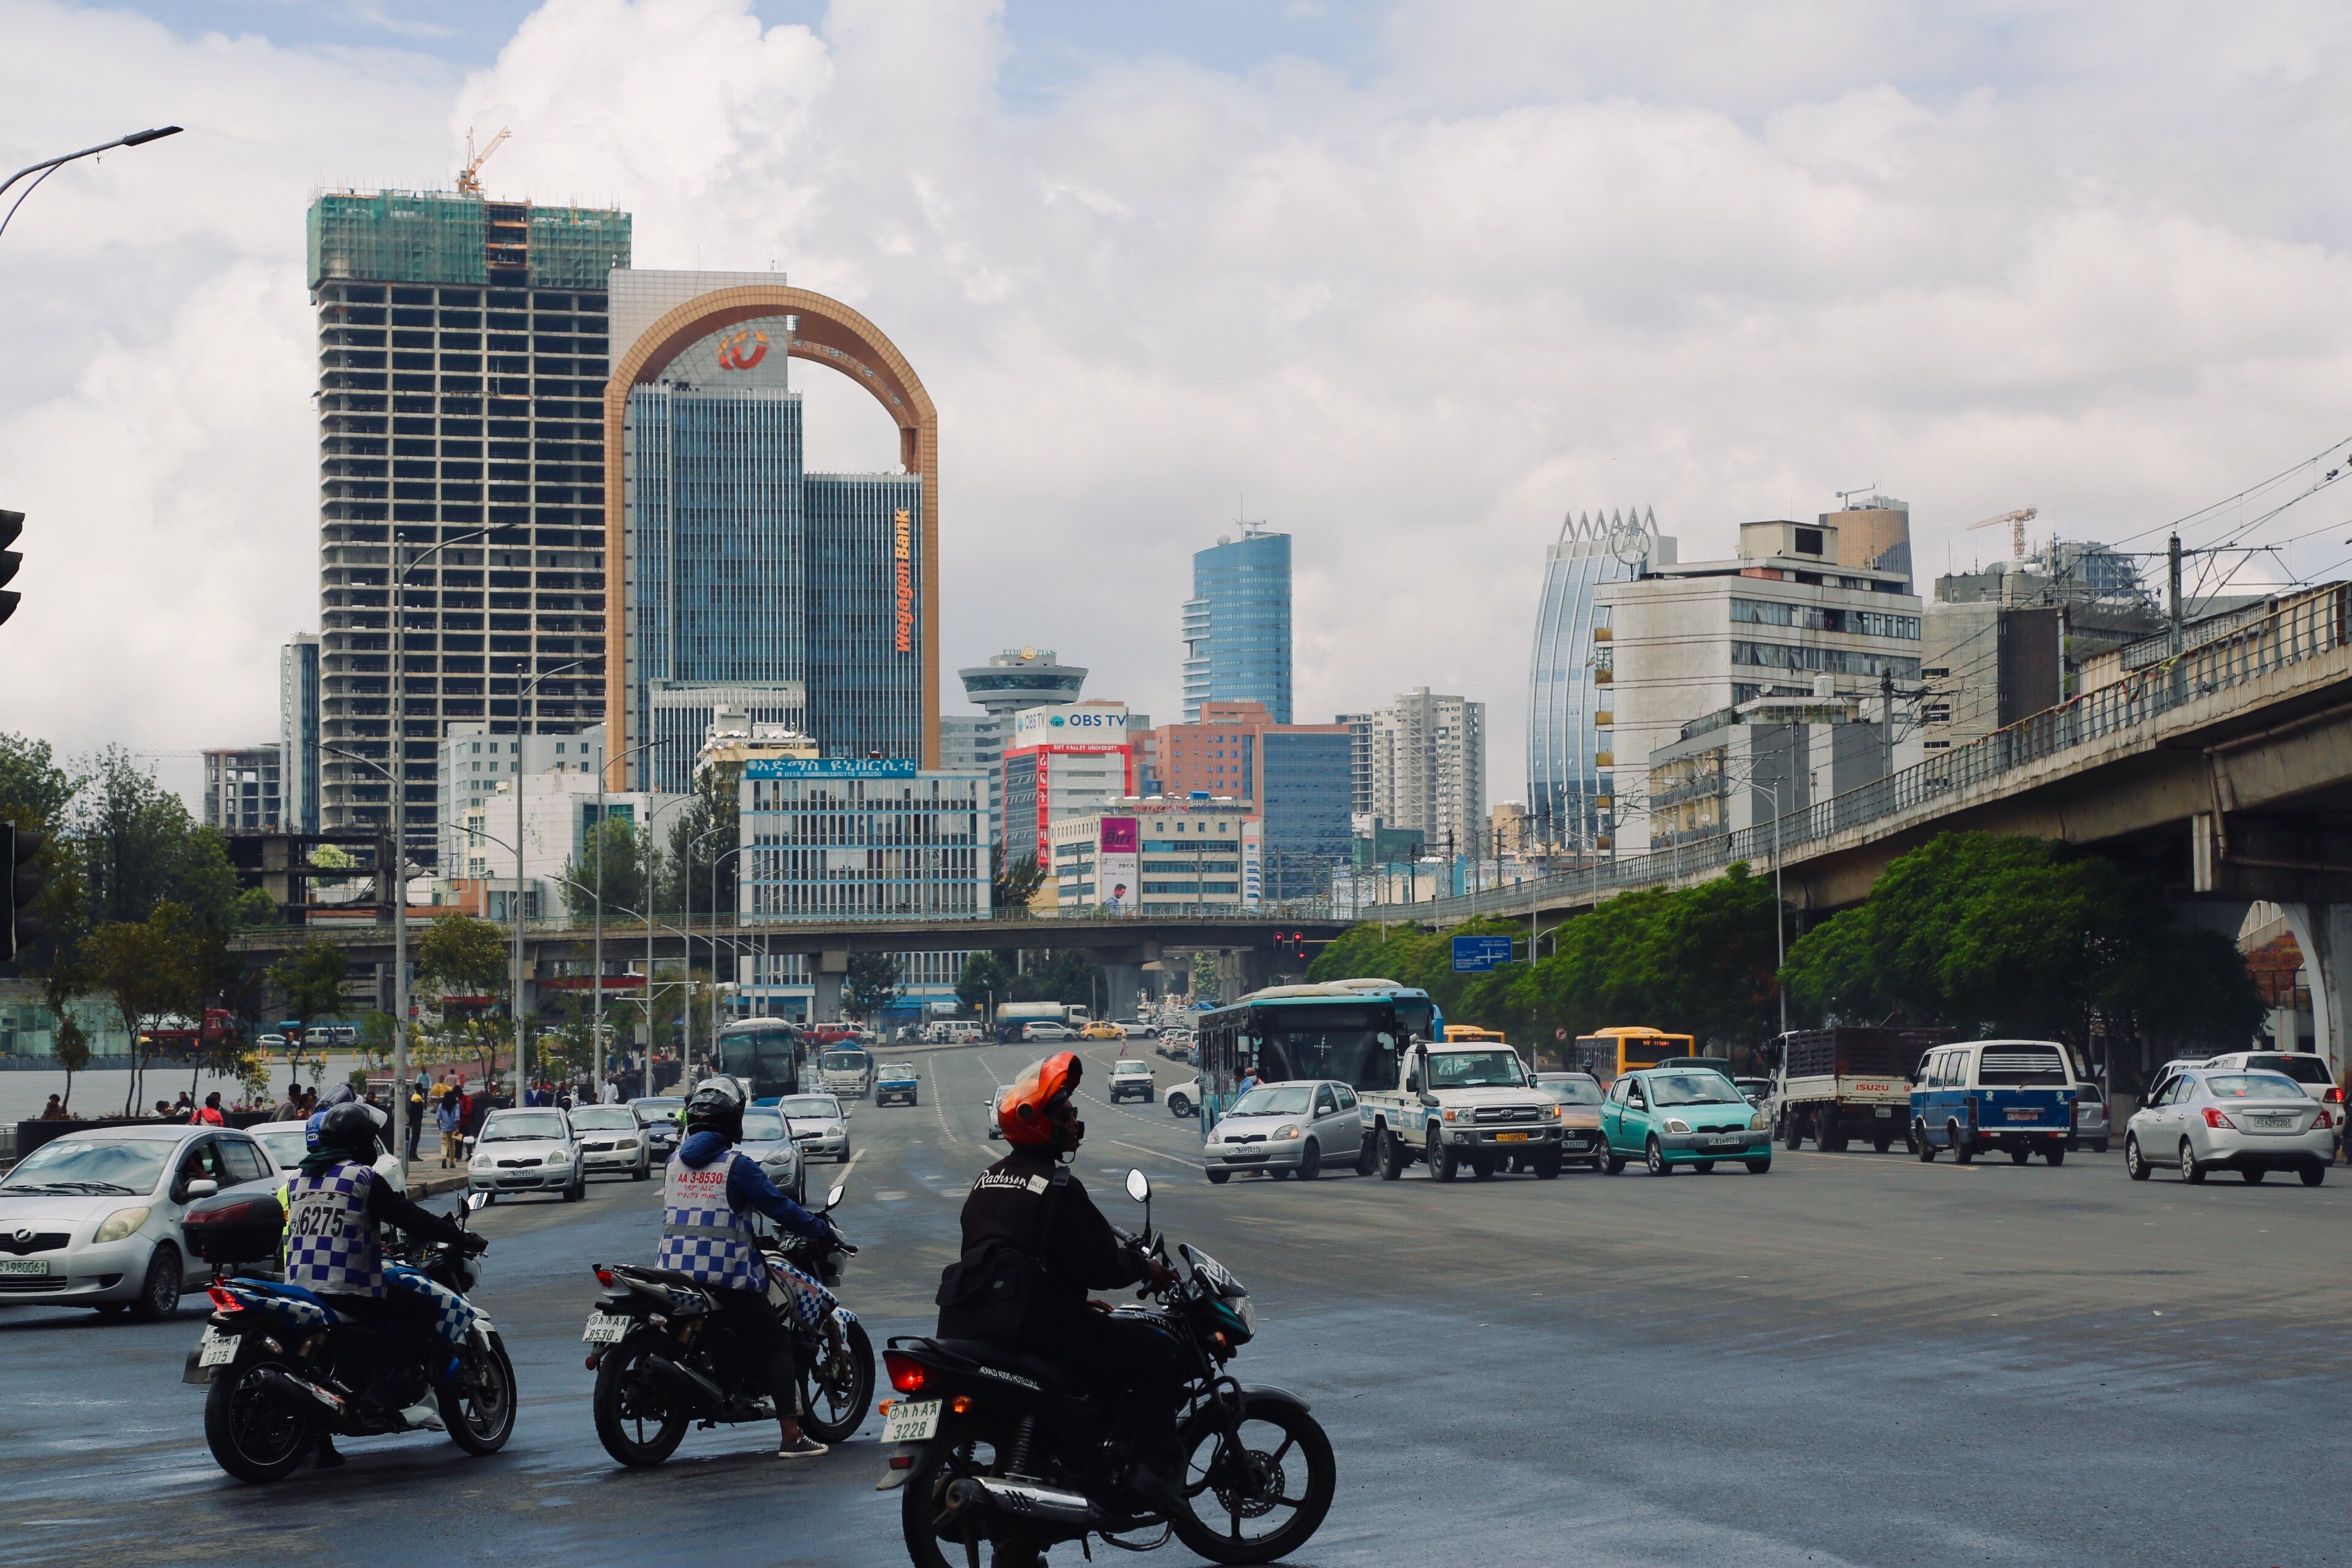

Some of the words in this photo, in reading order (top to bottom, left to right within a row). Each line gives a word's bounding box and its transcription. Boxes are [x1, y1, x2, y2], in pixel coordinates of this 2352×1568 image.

[894, 508, 910, 560] Bank
[1025, 714, 1036, 730] OBS
[1038, 712, 1045, 729] TV
[1069, 714, 1102, 726] OBS
[1105, 715, 1126, 726] TV
[757, 760, 819, 771] አድማስ
[830, 759, 914, 772] ዩኒቨርሲቲ
[1105, 830, 1135, 845] Birr
[677, 1173, 687, 1183] AA
[690, 1171, 723, 1185] 3-8530
[974, 1168, 1027, 1190] Radisson
[1030, 1180, 1045, 1190] BLU
[300, 1205, 345, 1237] 6275
[588, 1329, 614, 1341] 8530
[998, 1370, 1012, 1381] ADDIS
[893, 1421, 927, 1440] 3228
